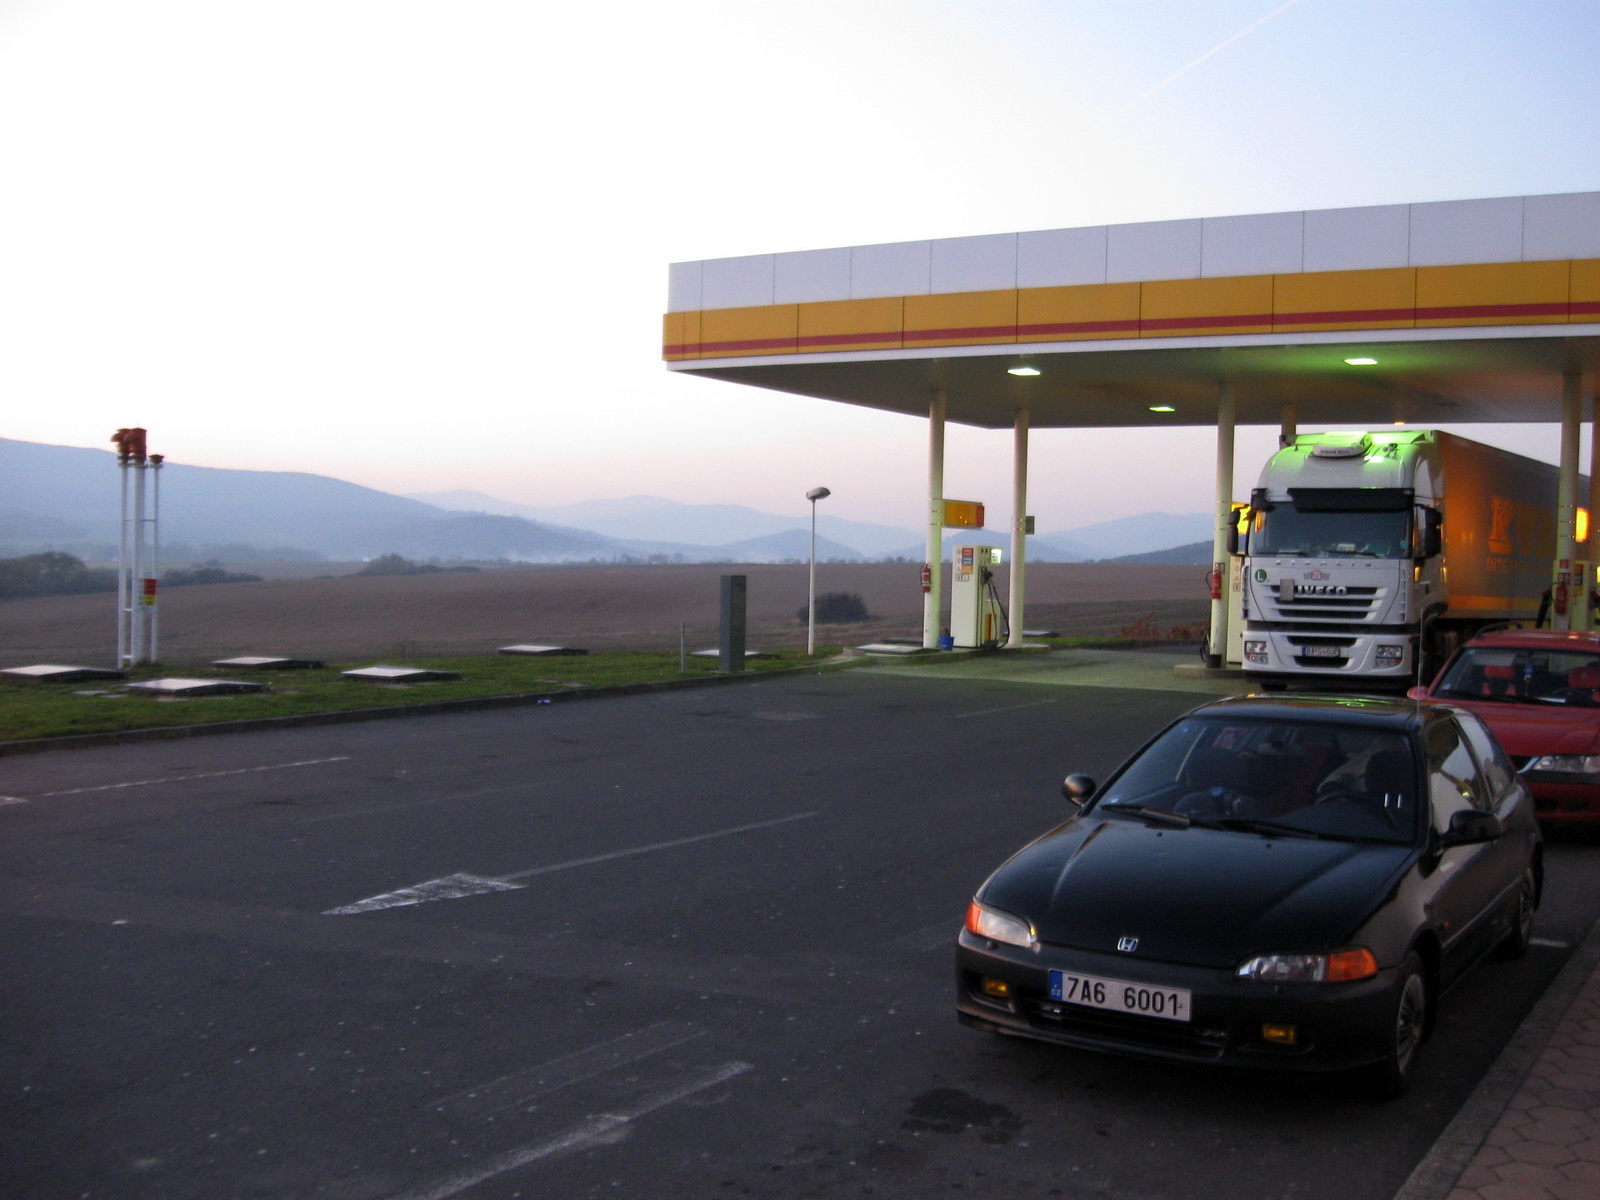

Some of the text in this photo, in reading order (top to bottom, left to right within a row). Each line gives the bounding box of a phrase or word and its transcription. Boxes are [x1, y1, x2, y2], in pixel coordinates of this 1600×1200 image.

[1297, 586, 1346, 596] IVECO
[1067, 977, 1178, 1016] 7A6 6001
